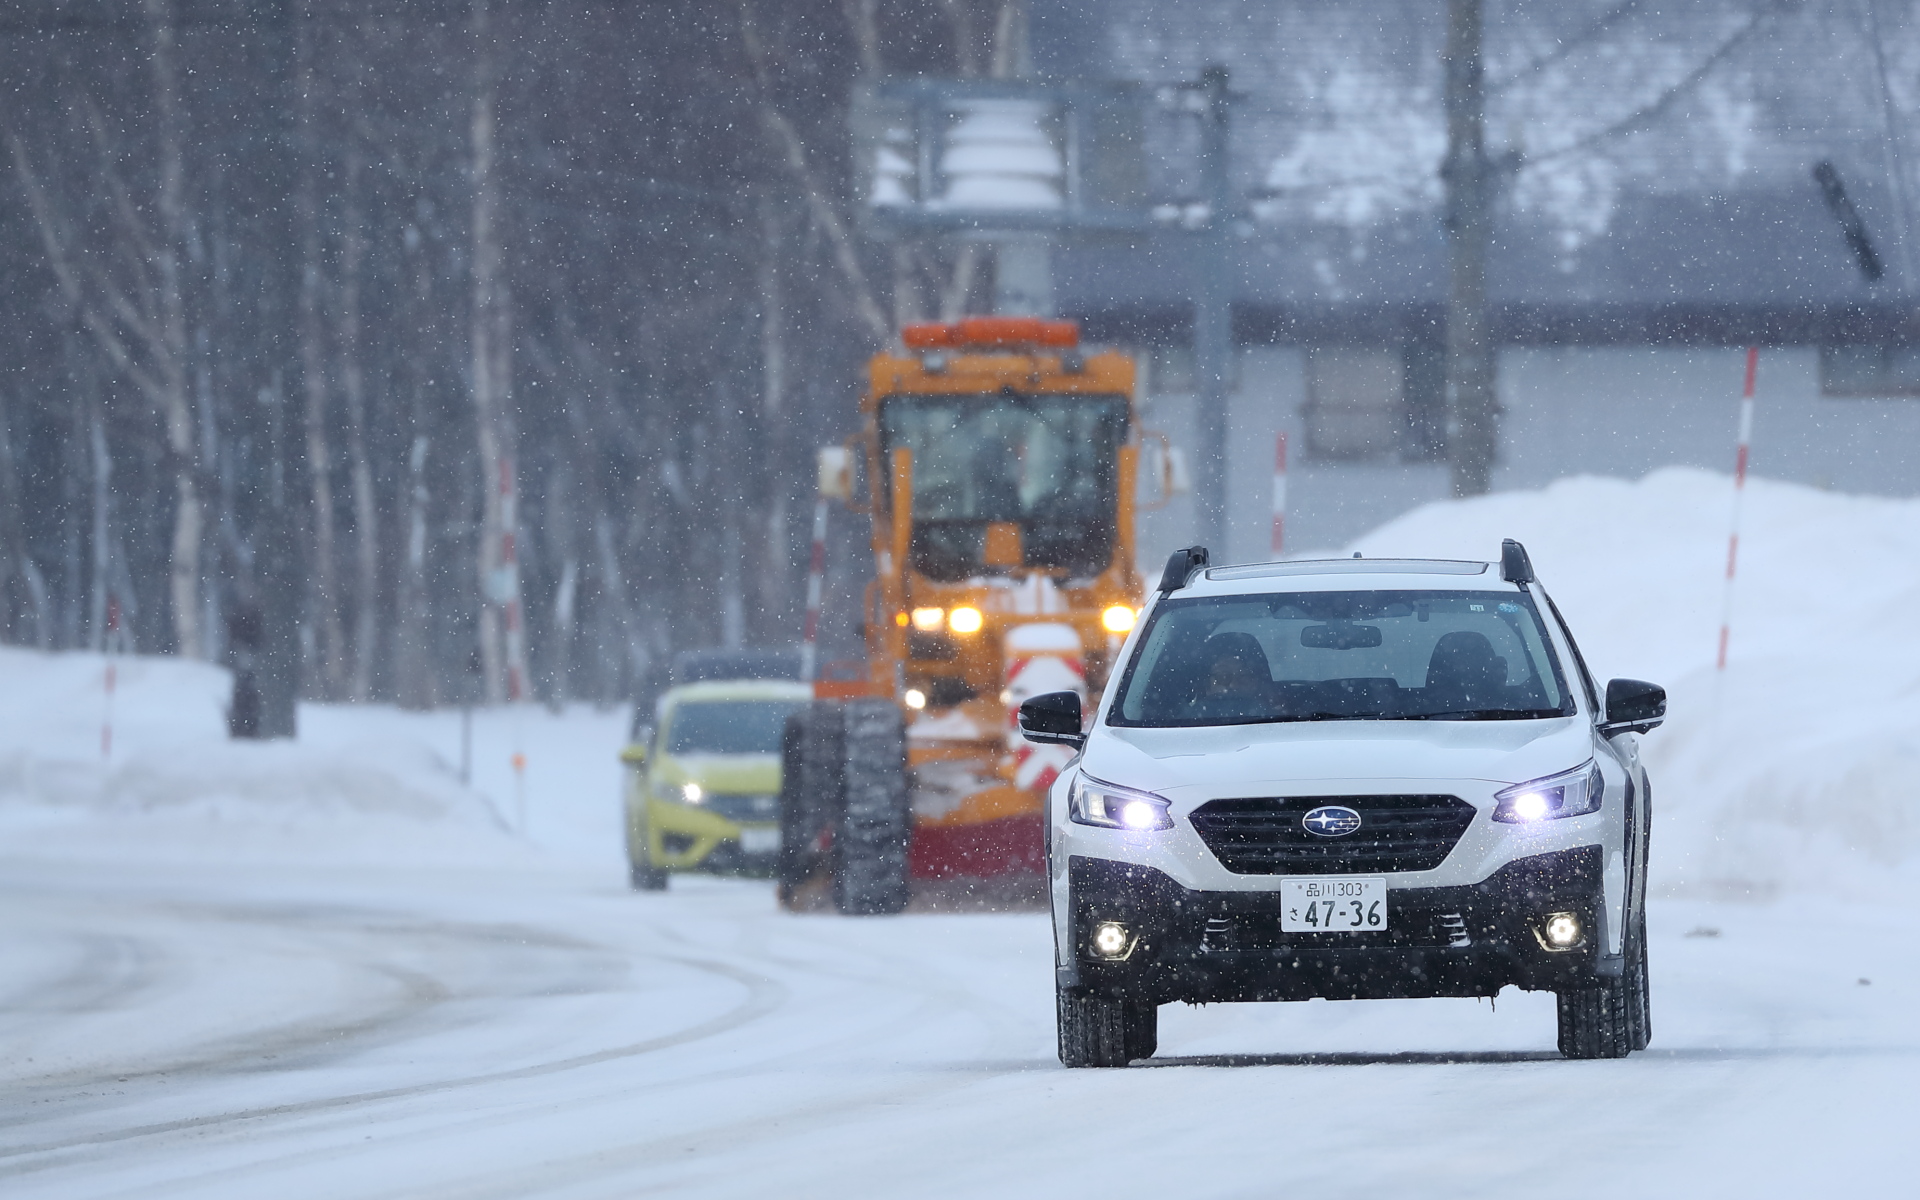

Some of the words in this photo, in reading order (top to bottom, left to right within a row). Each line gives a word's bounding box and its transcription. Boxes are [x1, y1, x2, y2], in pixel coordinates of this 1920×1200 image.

[1306, 882, 1363, 897] 品川303
[1289, 907, 1298, 922] さ
[1304, 900, 1381, 927] 47-36
